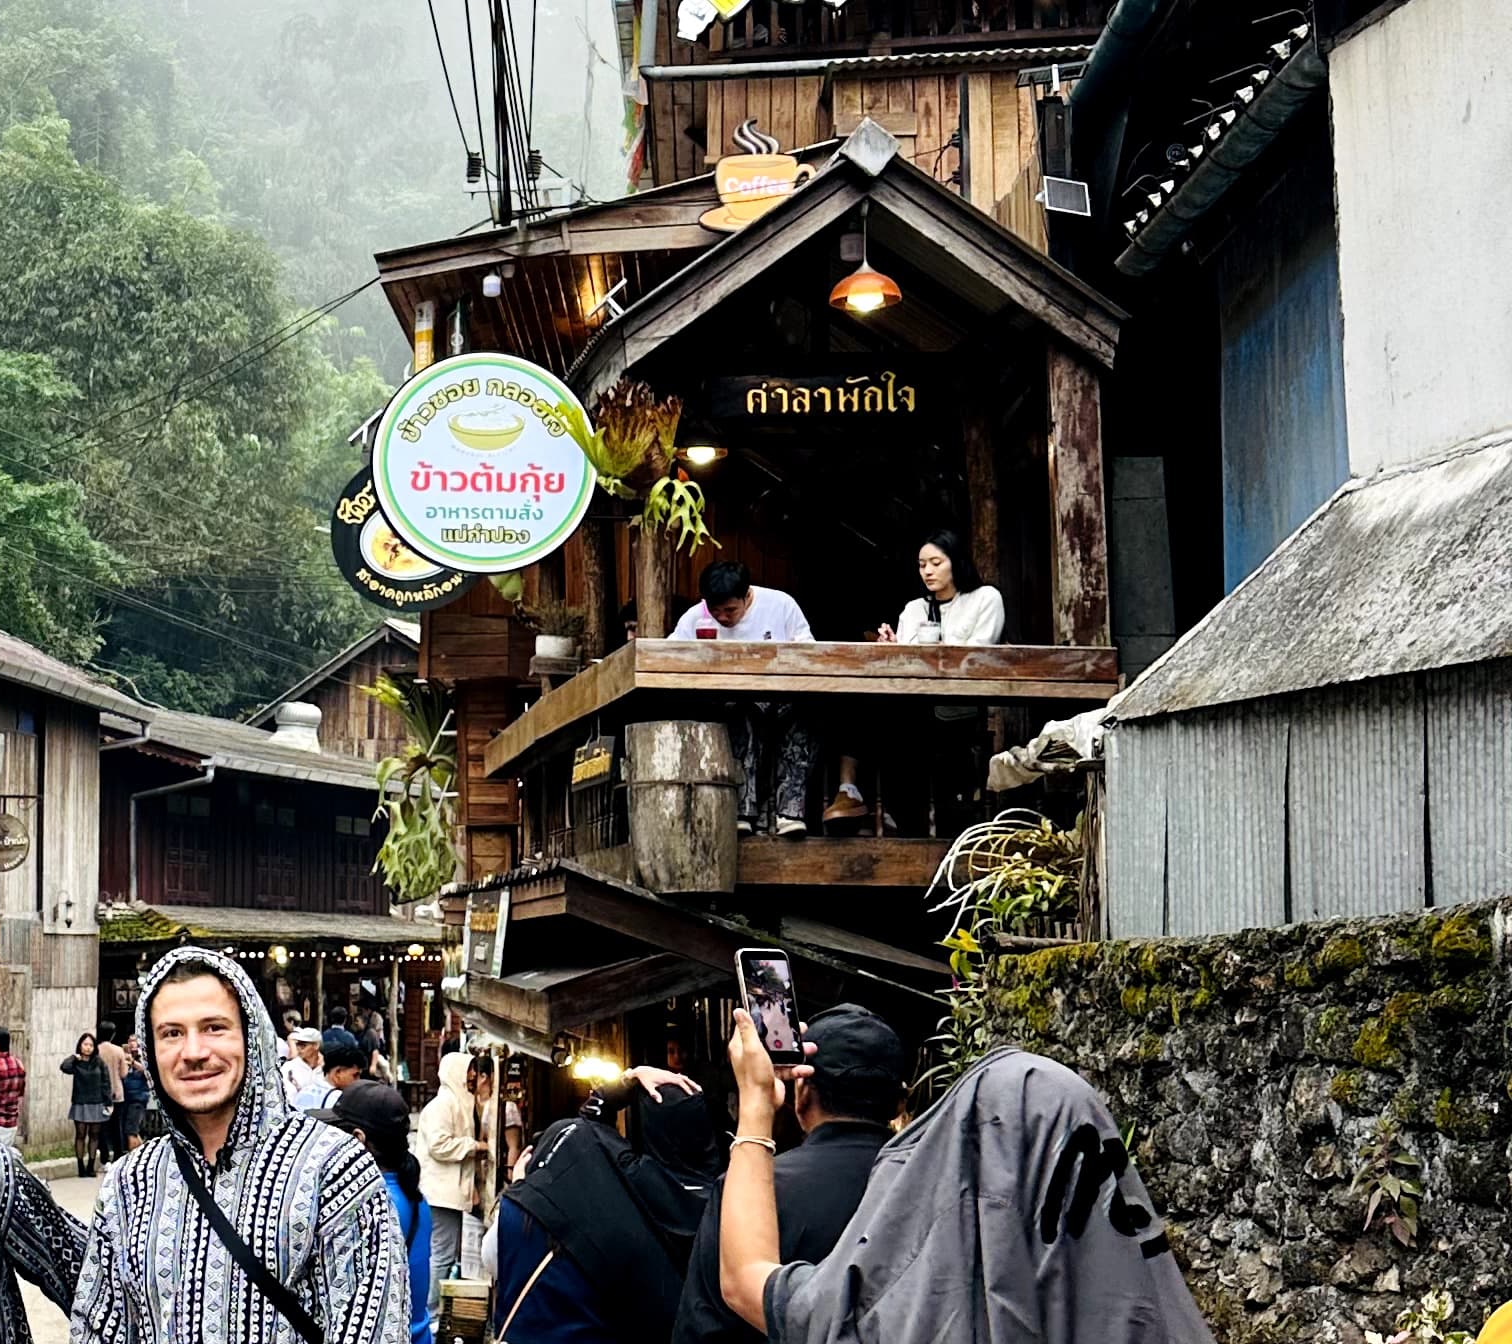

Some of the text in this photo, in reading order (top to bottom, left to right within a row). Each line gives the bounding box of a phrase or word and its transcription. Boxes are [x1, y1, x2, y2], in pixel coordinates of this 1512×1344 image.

[724, 175, 789, 195] Coffee
[746, 370, 916, 414] ศาลาพักใจ
[410, 461, 565, 503] ข้าวต้มกุ้ย
[425, 498, 544, 521] อาหารตามสั่ง
[441, 523, 531, 544] แม่กำปอง
